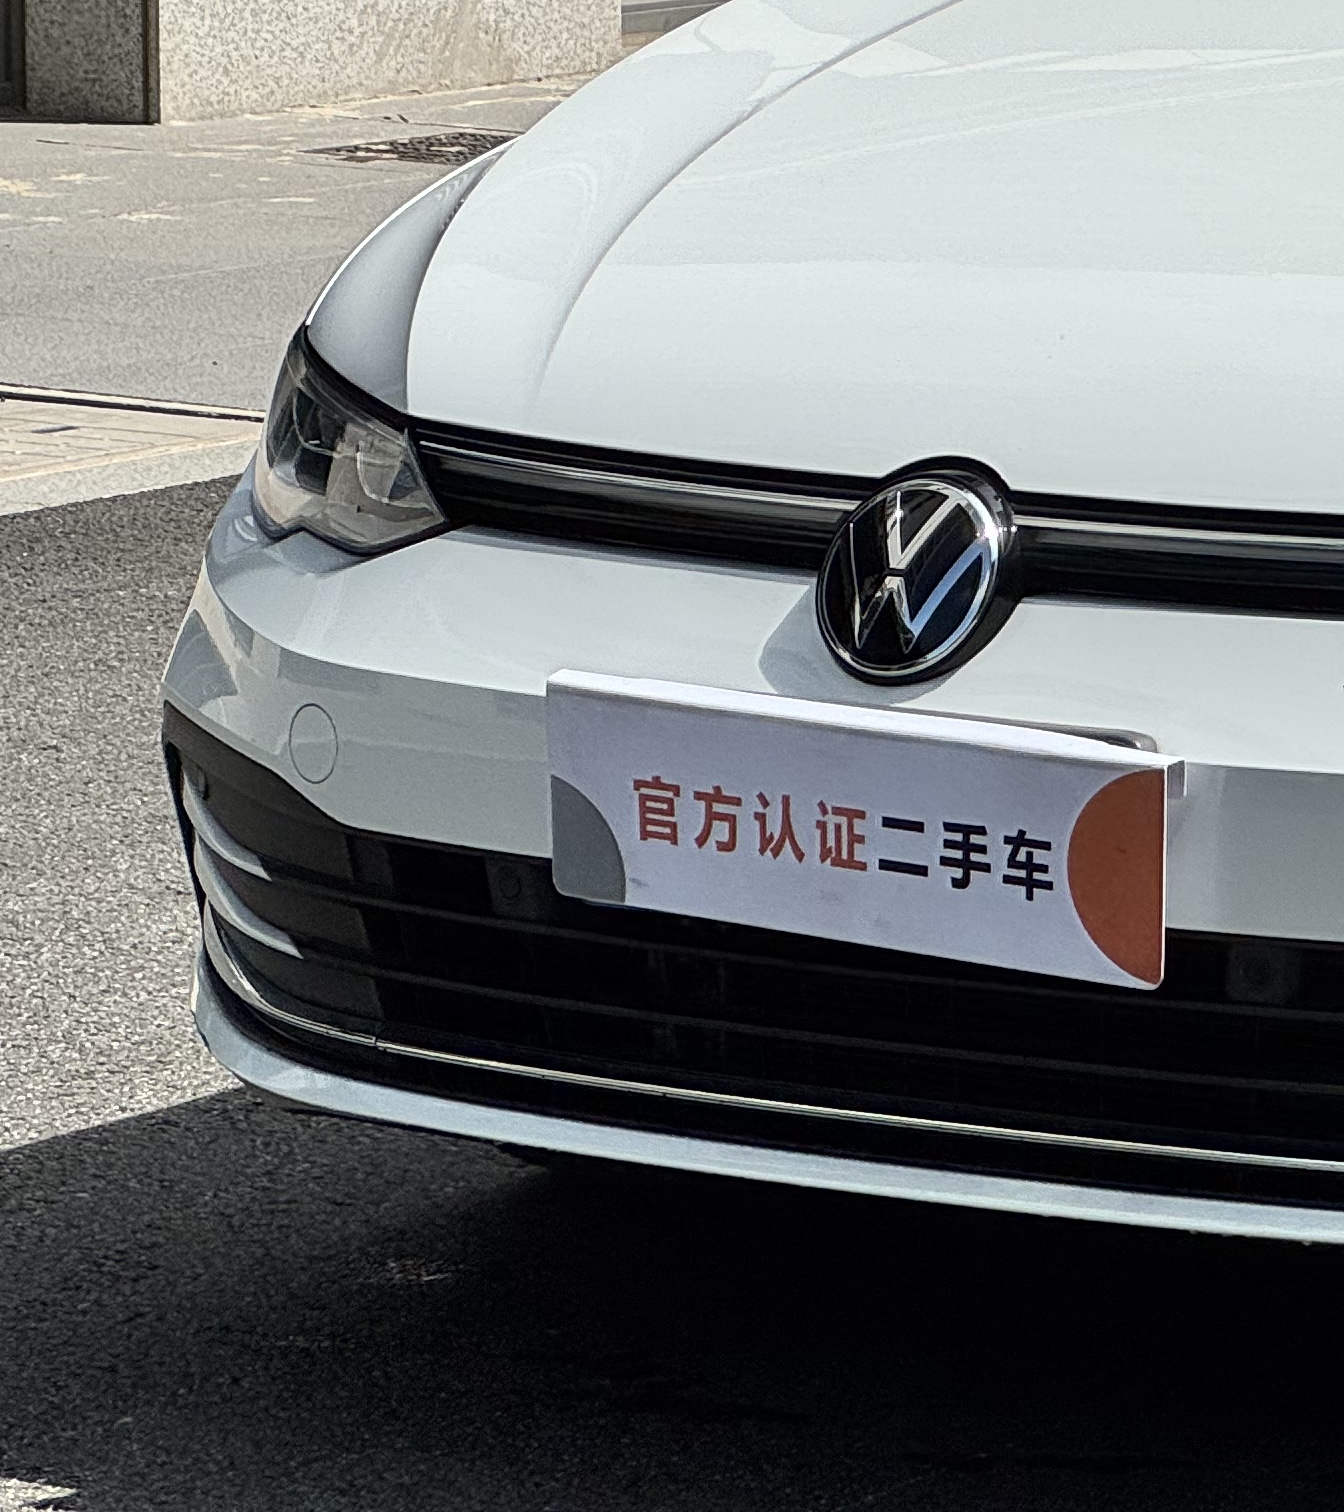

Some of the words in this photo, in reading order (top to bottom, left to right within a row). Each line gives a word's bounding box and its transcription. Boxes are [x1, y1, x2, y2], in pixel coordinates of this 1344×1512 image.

[632, 774, 1054, 901] 官方认证二手车
